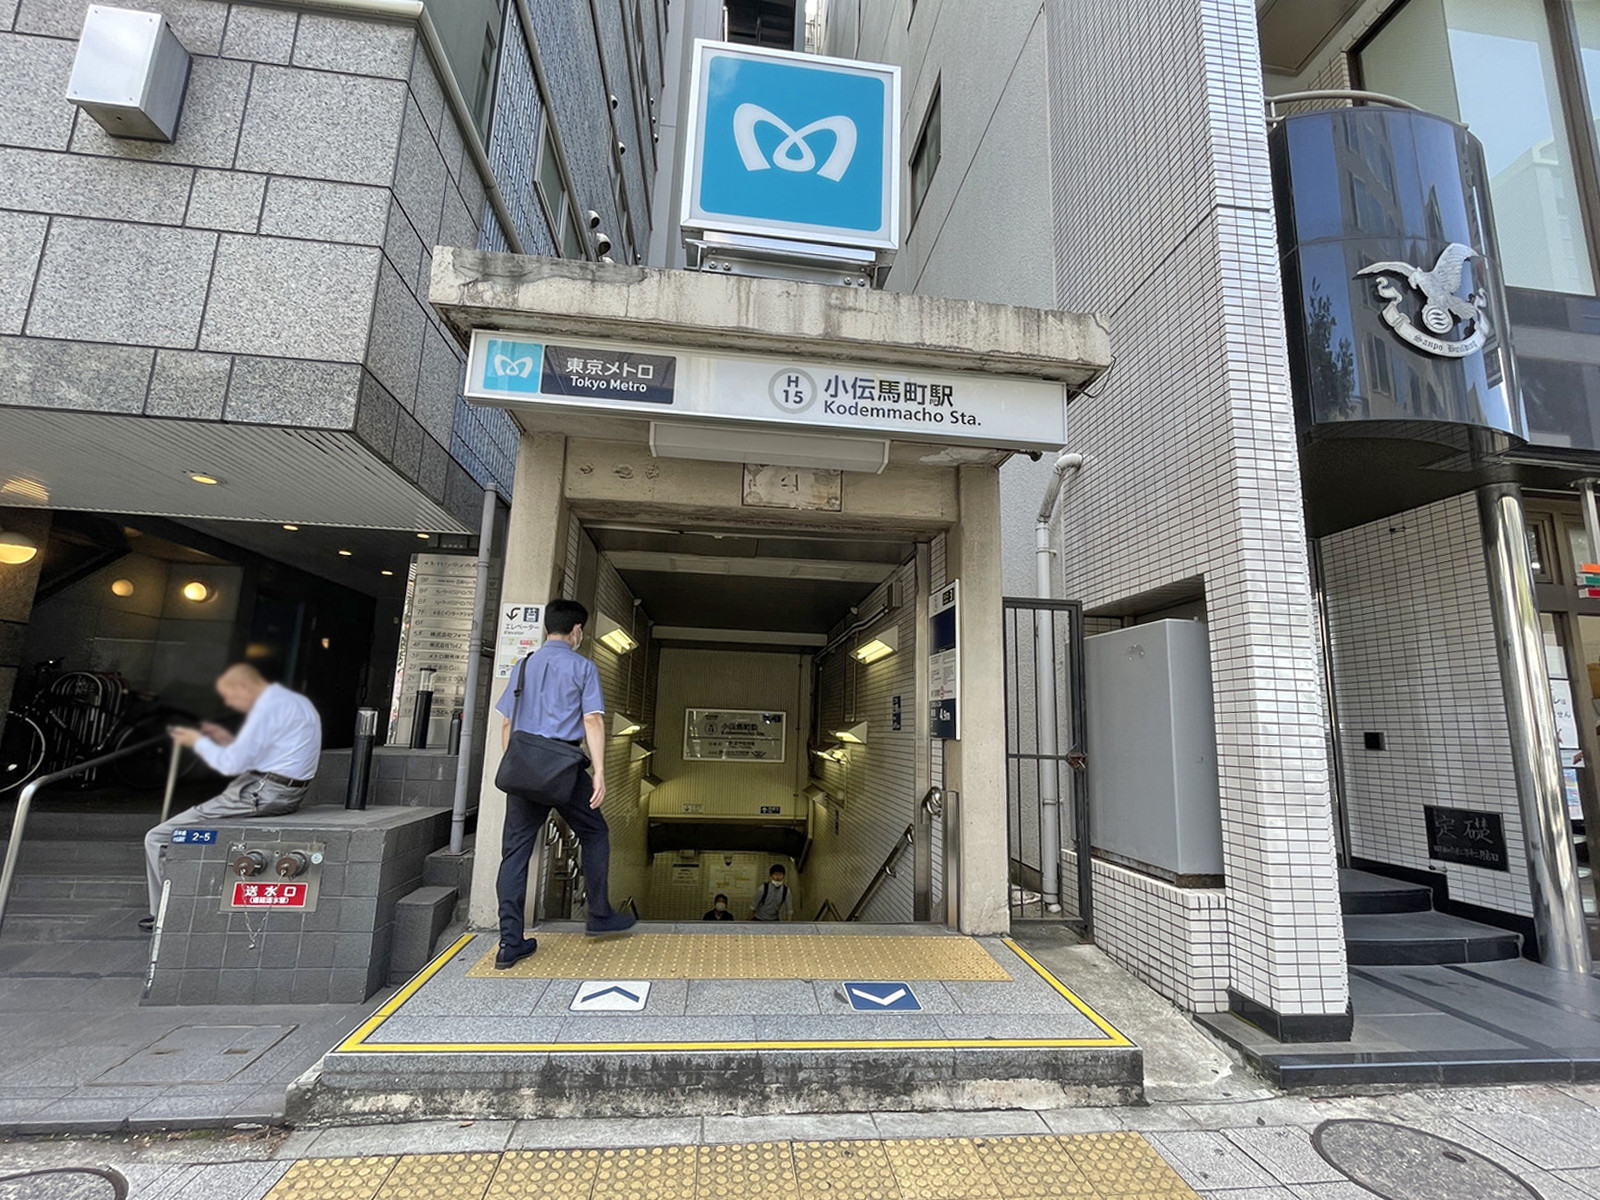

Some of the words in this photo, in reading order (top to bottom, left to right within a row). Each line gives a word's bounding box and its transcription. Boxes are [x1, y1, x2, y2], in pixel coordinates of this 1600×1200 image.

[1414, 335, 1443, 352] Sanpo
[565, 356, 654, 379] 東京メトロ
[570, 376, 607, 390] Tokyo
[610, 379, 647, 392] Metro
[787, 375, 800, 388] H
[783, 390, 804, 404] 15
[824, 375, 954, 407] 小伝馬町駅
[824, 401, 944, 424] Kodemmacho
[950, 411, 982, 426] Sta.
[504, 623, 540, 631] エレベーター
[192, 833, 211, 842] 2-5
[245, 885, 297, 897] 送水口
